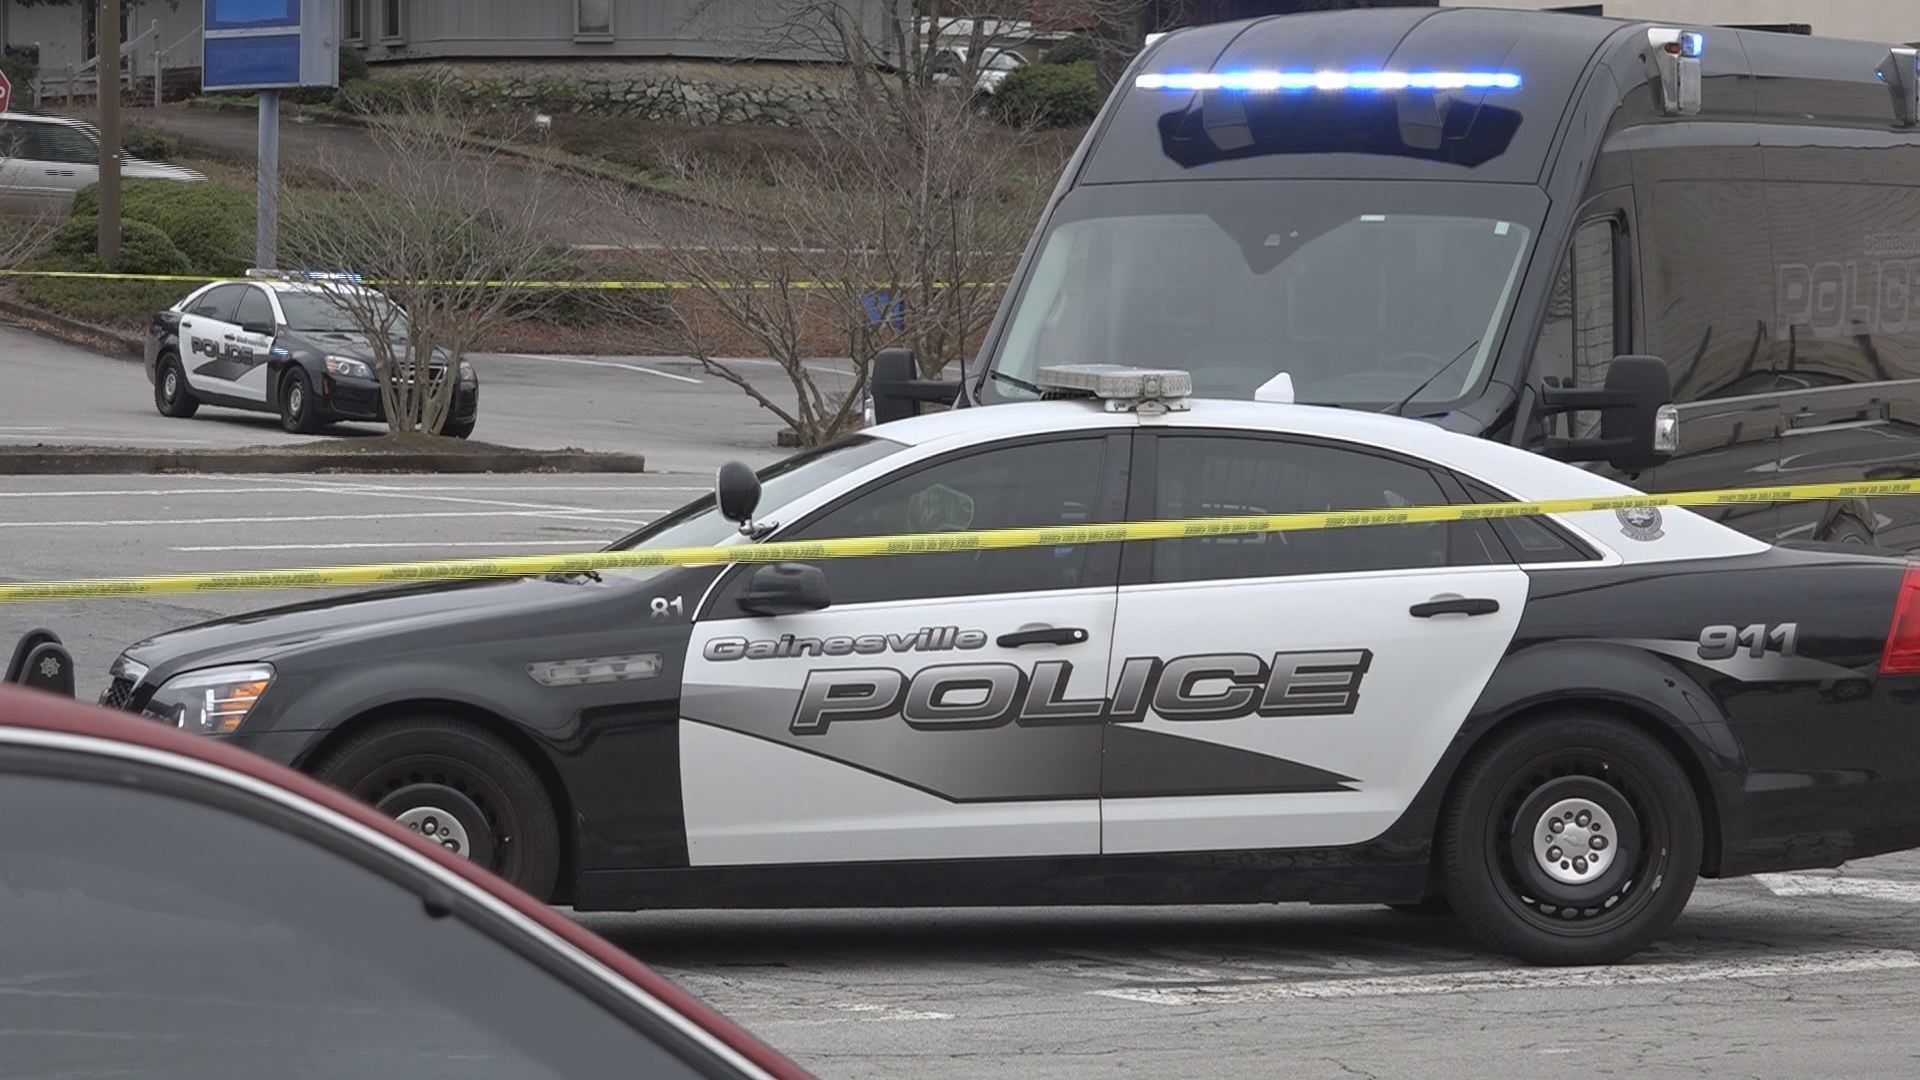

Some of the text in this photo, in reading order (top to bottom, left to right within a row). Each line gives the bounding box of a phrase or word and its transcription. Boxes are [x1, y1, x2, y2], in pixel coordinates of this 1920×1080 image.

[191, 335, 254, 366] POLICE
[650, 595, 684, 620] 81
[703, 626, 988, 662] Gainesville
[1697, 622, 1798, 660] 911
[788, 648, 1374, 736] POLICE
